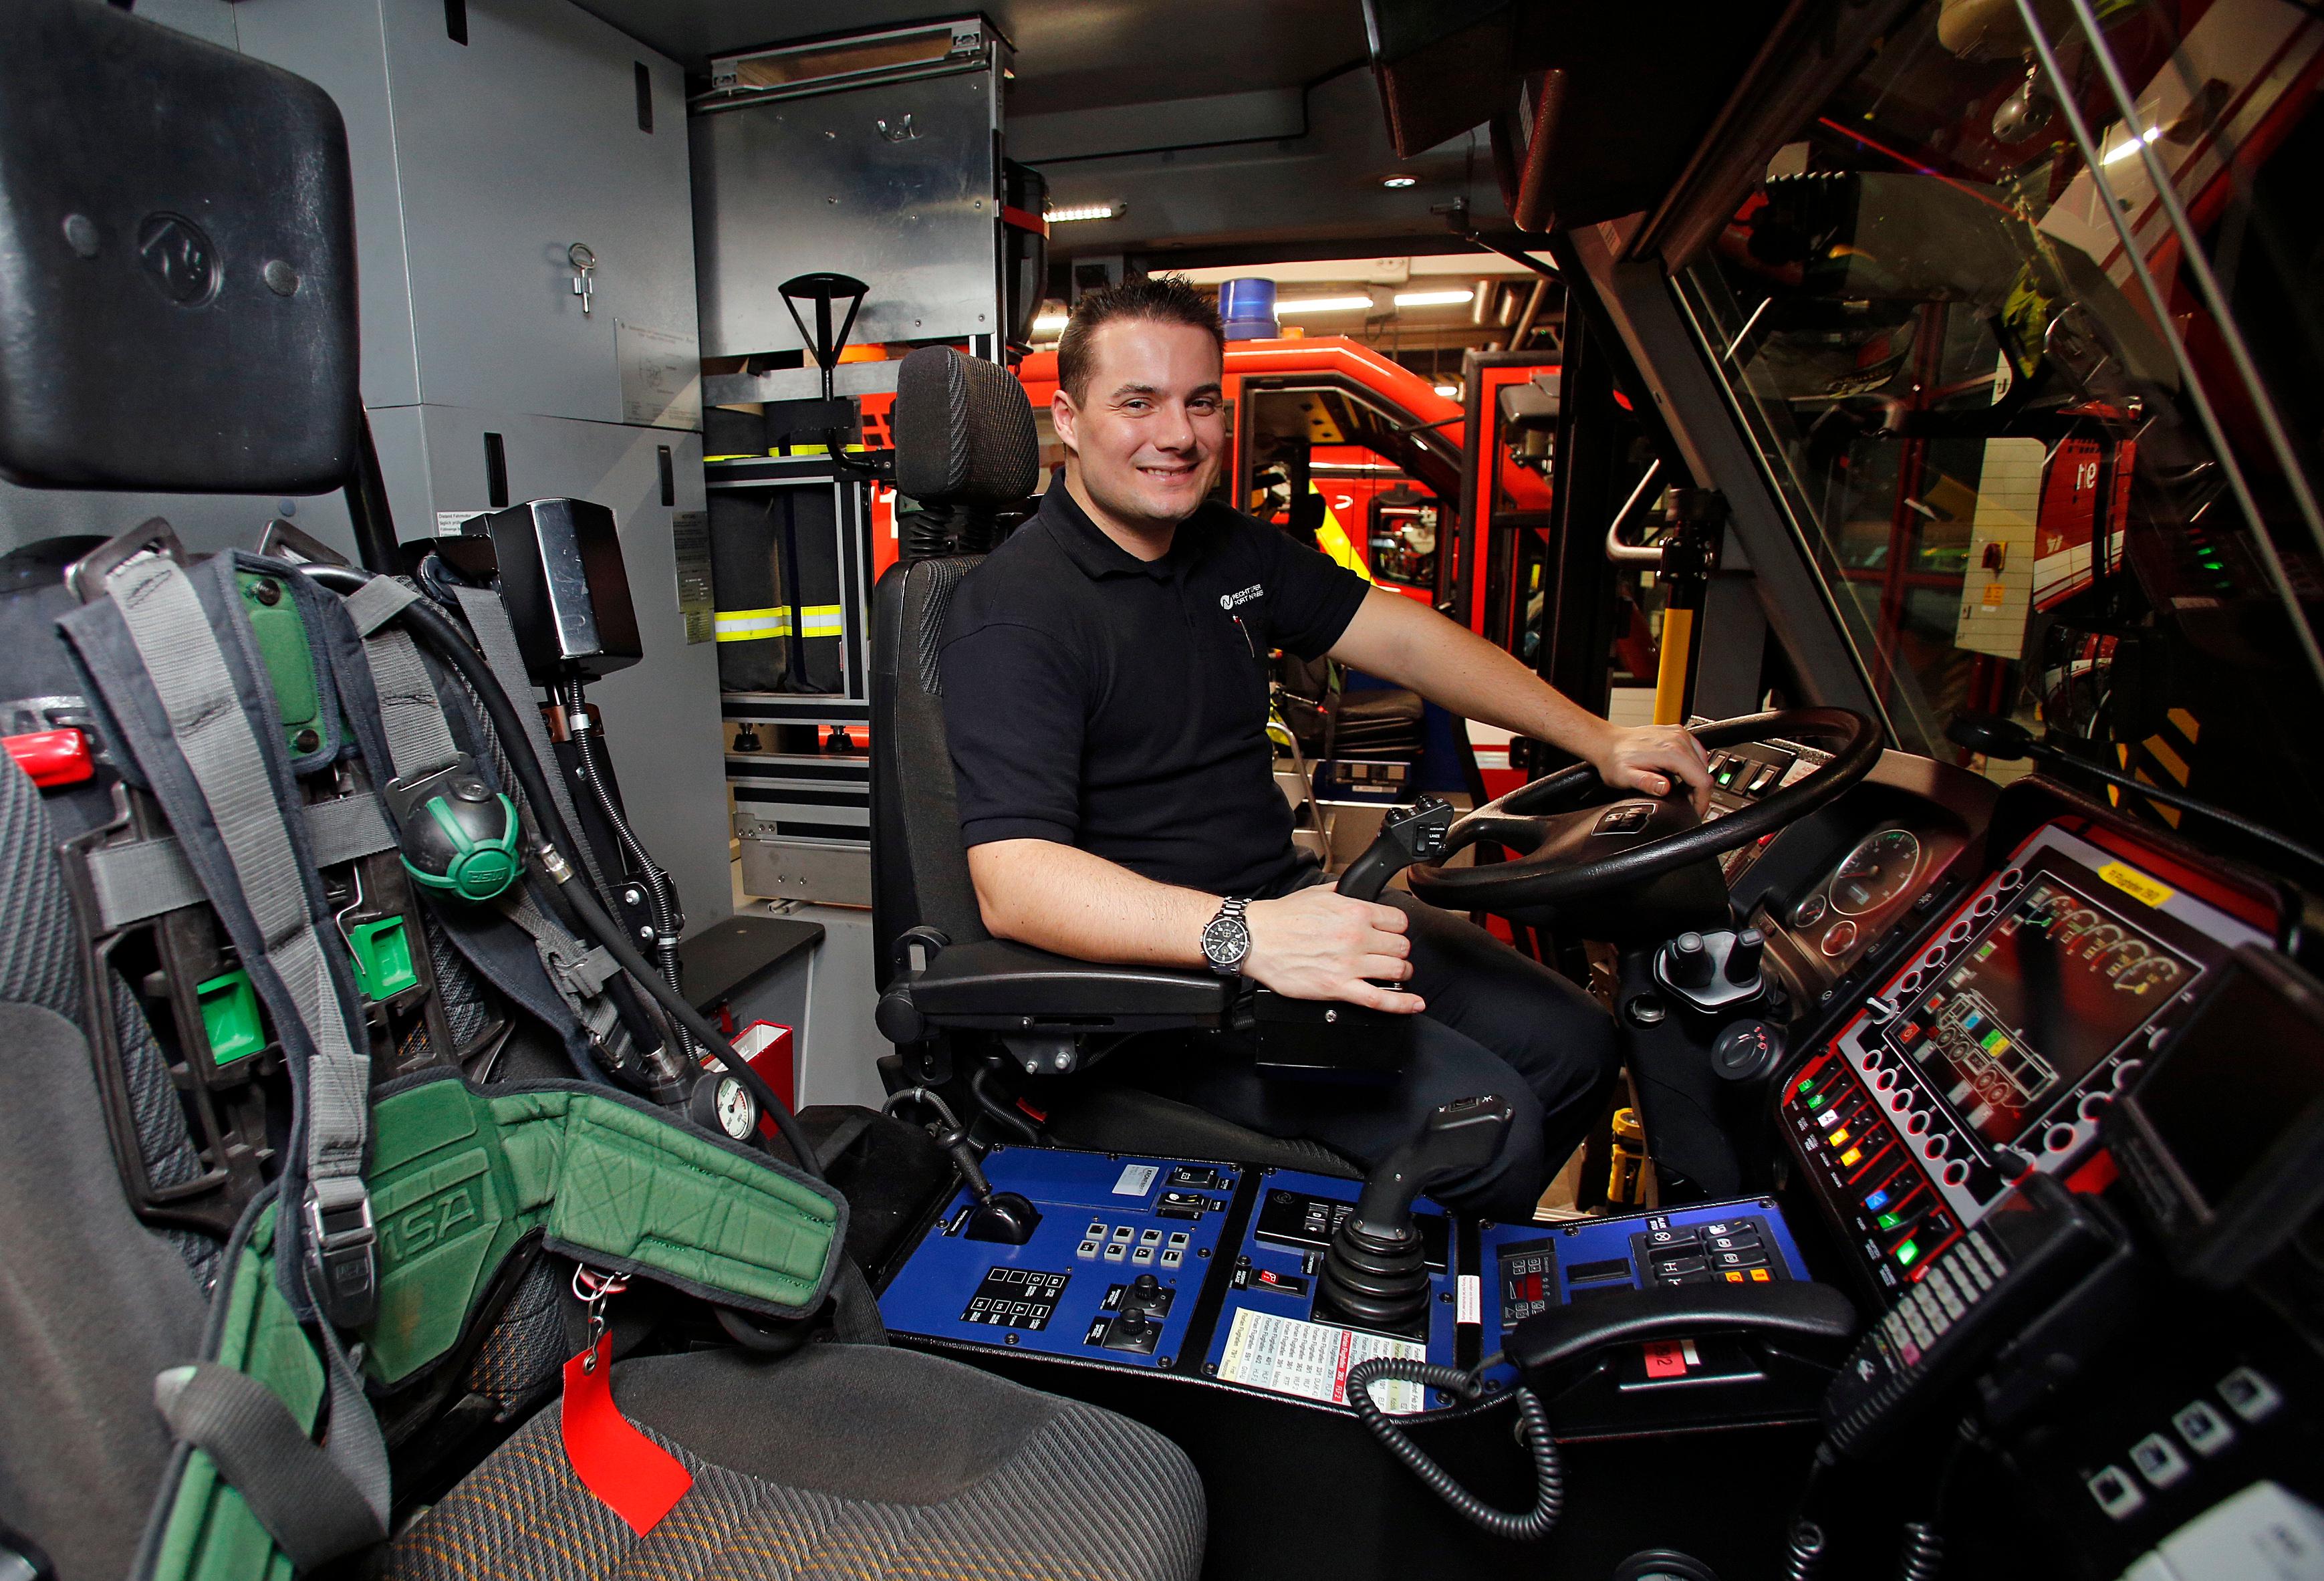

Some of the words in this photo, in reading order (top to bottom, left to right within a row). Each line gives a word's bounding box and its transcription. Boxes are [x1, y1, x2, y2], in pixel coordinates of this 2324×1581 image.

[1238, 1312, 1248, 1326] Florian
[1251, 1314, 1261, 1330] Florian
[1263, 1316, 1272, 1332] Florian
[1272, 1318, 1281, 1334] Florian
[1231, 1326, 1244, 1346] Flughafen
[1283, 1320, 1291, 1336] Florian
[1292, 1322, 1301, 1337] Florian
[1301, 1324, 1310, 1339] Florian
[1311, 1326, 1319, 1341] Florian
[1320, 1328, 1329, 1343] Florian
[1245, 1328, 1257, 1350] Flughafen
[1256, 1331, 1269, 1352] Flughafen
[1265, 1332, 1278, 1354] Flughafen
[1277, 1334, 1289, 1356] Flughafen
[1331, 1330, 1340, 1345] Florian
[1341, 1332, 1350, 1347] Florian
[1286, 1336, 1298, 1358] Flughafen
[1296, 1338, 1307, 1360] Flughafen
[1306, 1340, 1317, 1362] Flughafen
[1315, 1342, 1327, 1364] Flughafen
[1327, 1344, 1337, 1366] Flughafen
[1337, 1346, 1348, 1369] Flughafen
[1336, 1370, 1345, 1381] 29/2
[1334, 1384, 1343, 1395] FLF
